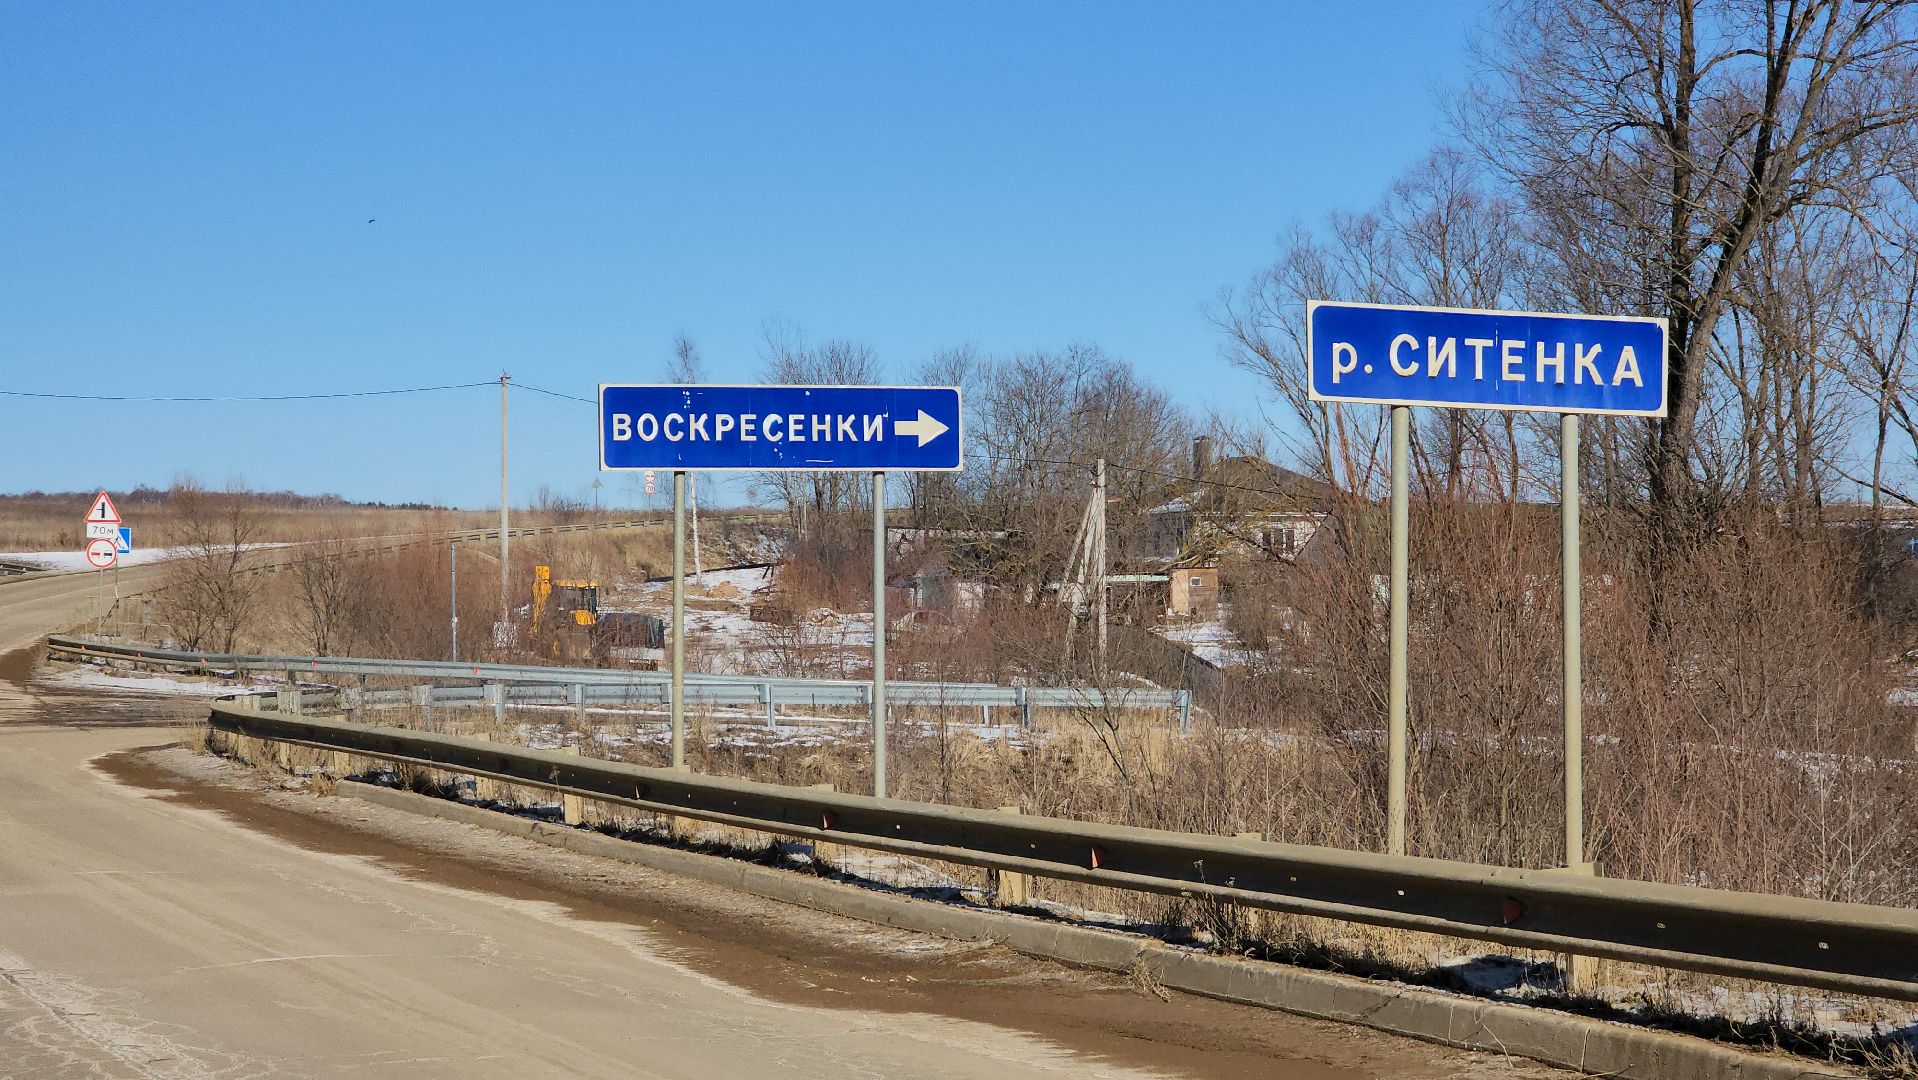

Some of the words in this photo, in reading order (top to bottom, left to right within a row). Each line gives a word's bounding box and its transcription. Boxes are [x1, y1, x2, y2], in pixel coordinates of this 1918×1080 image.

[1332, 342, 1373, 384] р.
[1389, 333, 1644, 387] СИТЕНКА
[613, 413, 883, 442] ВОСКРЕСЕНКИ
